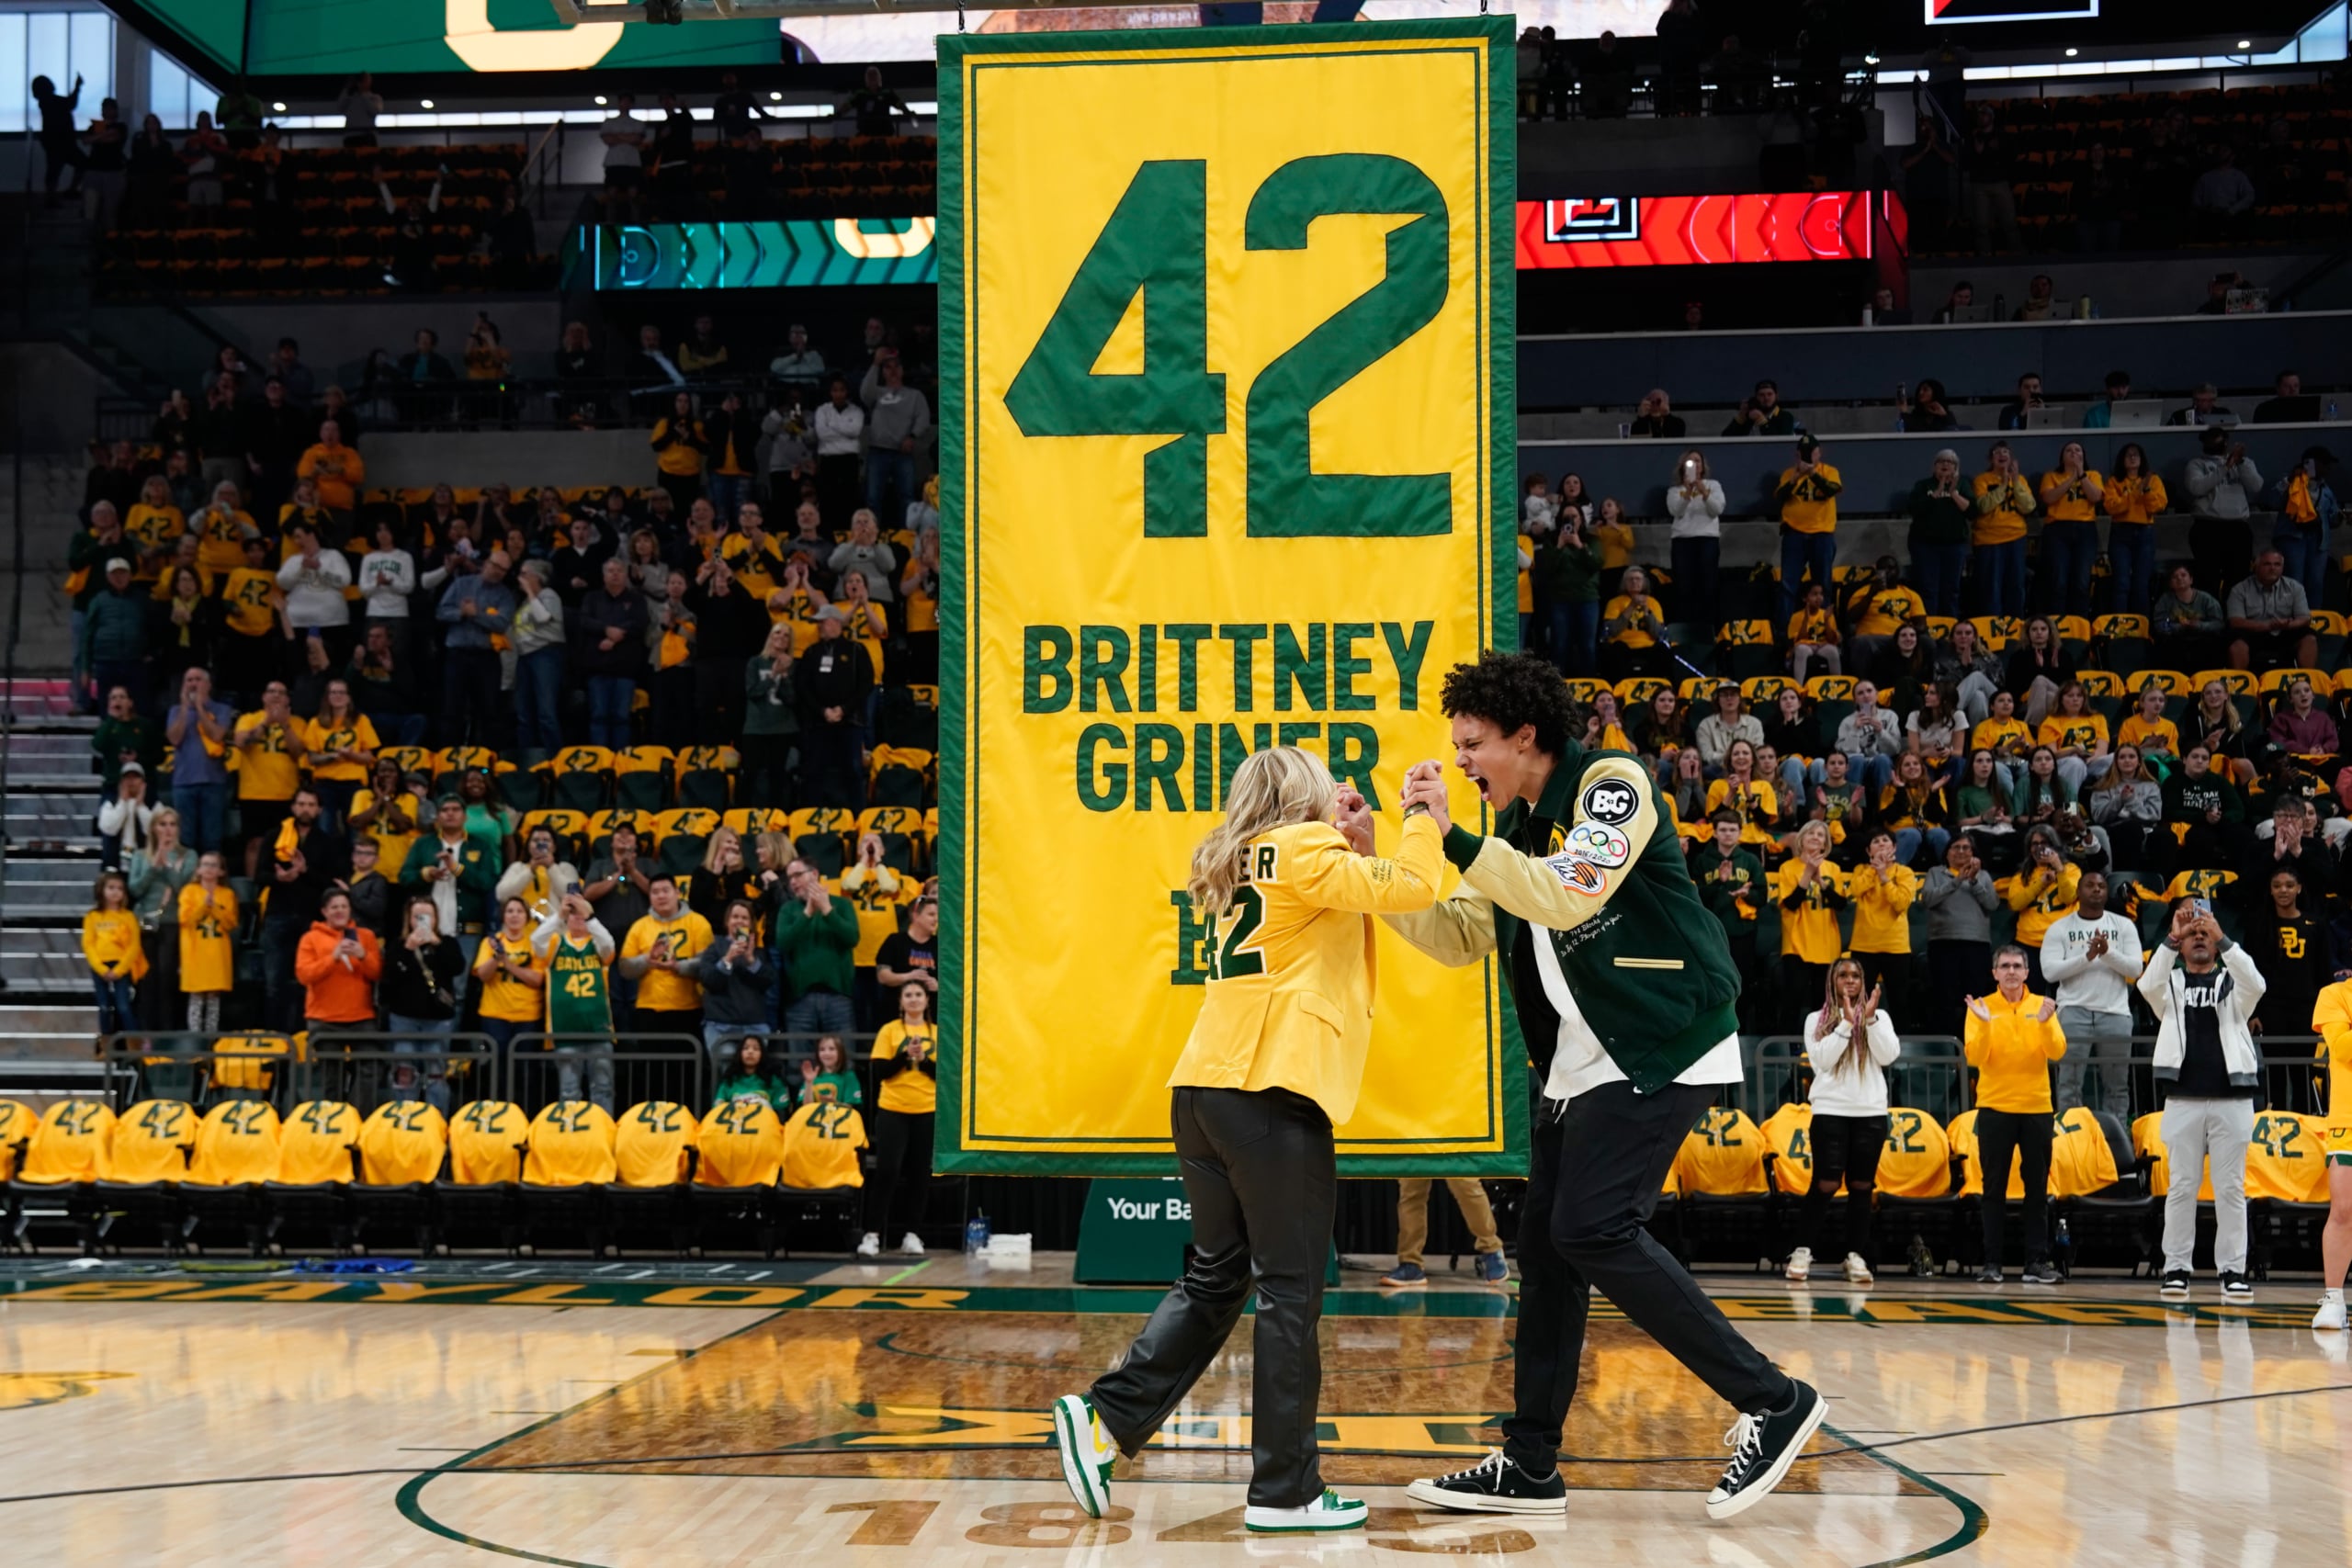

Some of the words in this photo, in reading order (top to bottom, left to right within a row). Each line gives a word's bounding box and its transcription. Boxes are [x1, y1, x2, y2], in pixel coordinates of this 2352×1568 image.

[1004, 152, 1452, 538] 42
[140, 517, 171, 542] 42
[240, 579, 273, 607] 42
[1878, 598, 1911, 622] 42
[1023, 620, 1435, 714] BRITTNEY
[1752, 679, 1784, 701] 42
[1818, 679, 1851, 701] 42
[2062, 725, 2098, 754] 42
[1076, 721, 1383, 812] GRINR
[1591, 789, 1631, 816] BG
[2278, 926, 2306, 959] BU
[564, 972, 596, 998] 42
[2184, 986, 2217, 1008] AYLO
[53, 1100, 101, 1135] 42
[139, 1100, 185, 1139] 42
[220, 1100, 267, 1135] 42
[300, 1100, 345, 1134] 42
[381, 1100, 430, 1133] 42
[463, 1100, 511, 1134] 42
[546, 1100, 593, 1133] 42
[636, 1101, 683, 1134] 42
[715, 1101, 764, 1135] 42
[805, 1101, 853, 1140] 42
[1692, 1107, 1743, 1147] 42
[1787, 1126, 1814, 1170] 4
[2251, 1114, 2304, 1159] 42
[1107, 1197, 1160, 1220] Your
[1166, 1198, 1193, 1221] Ba
[4, 1280, 971, 1310] BAYLOR
